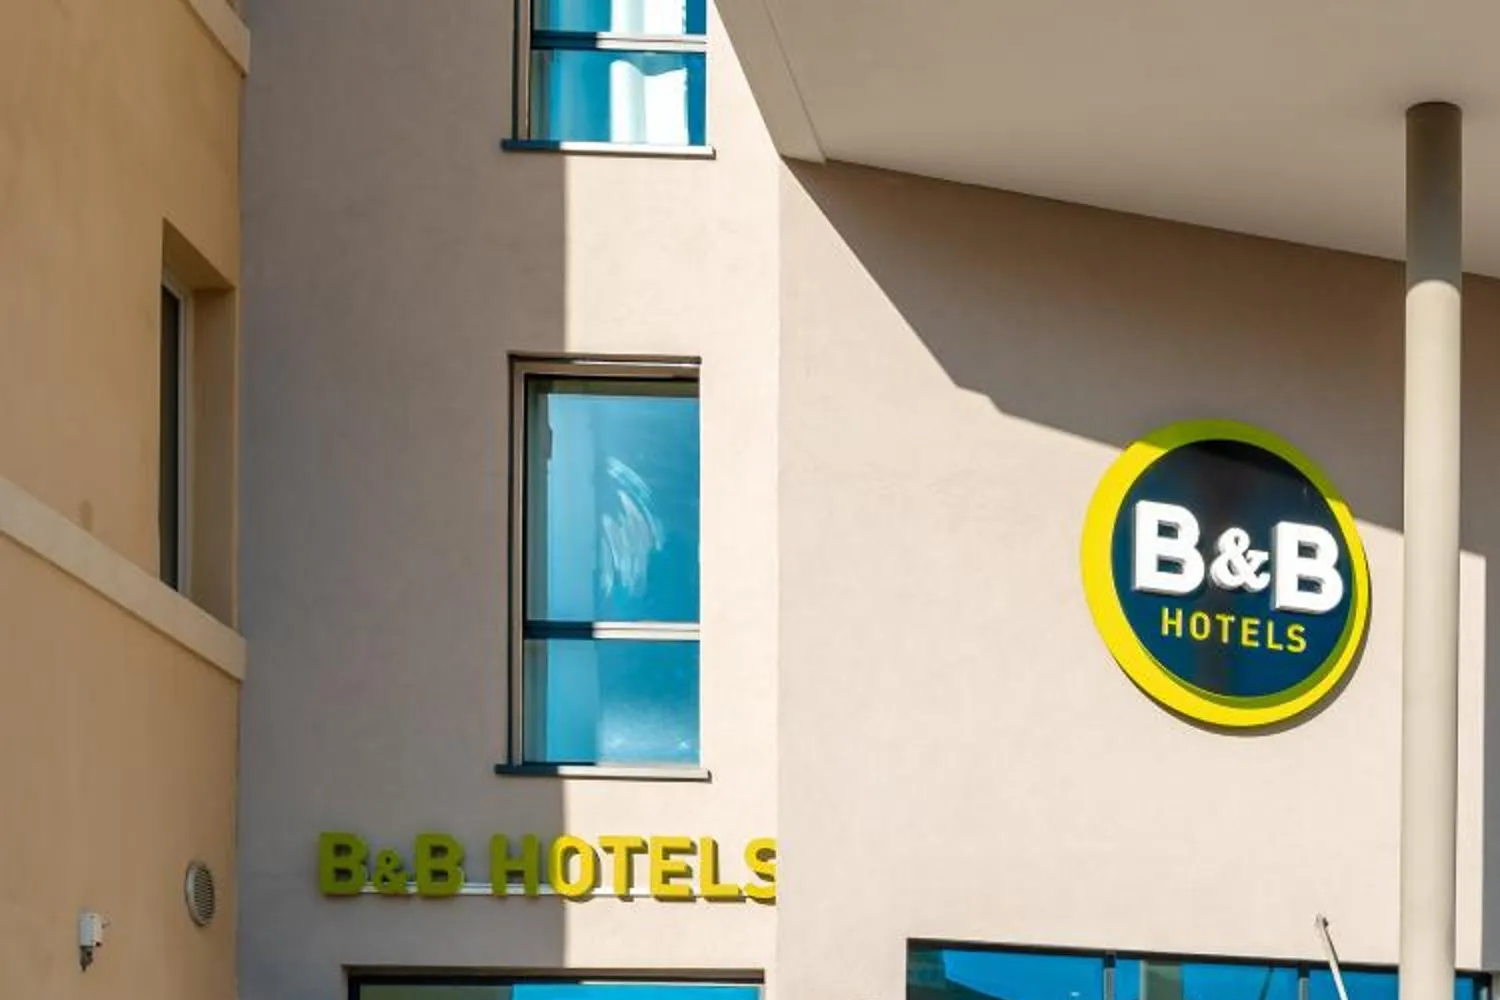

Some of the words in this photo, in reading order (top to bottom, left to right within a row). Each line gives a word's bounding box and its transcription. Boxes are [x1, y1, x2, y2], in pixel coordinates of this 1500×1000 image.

[1132, 500, 1344, 614] B&B
[1160, 606, 1307, 653] HOTELS
[318, 831, 465, 897] B&B
[489, 833, 777, 900] HOTELS
